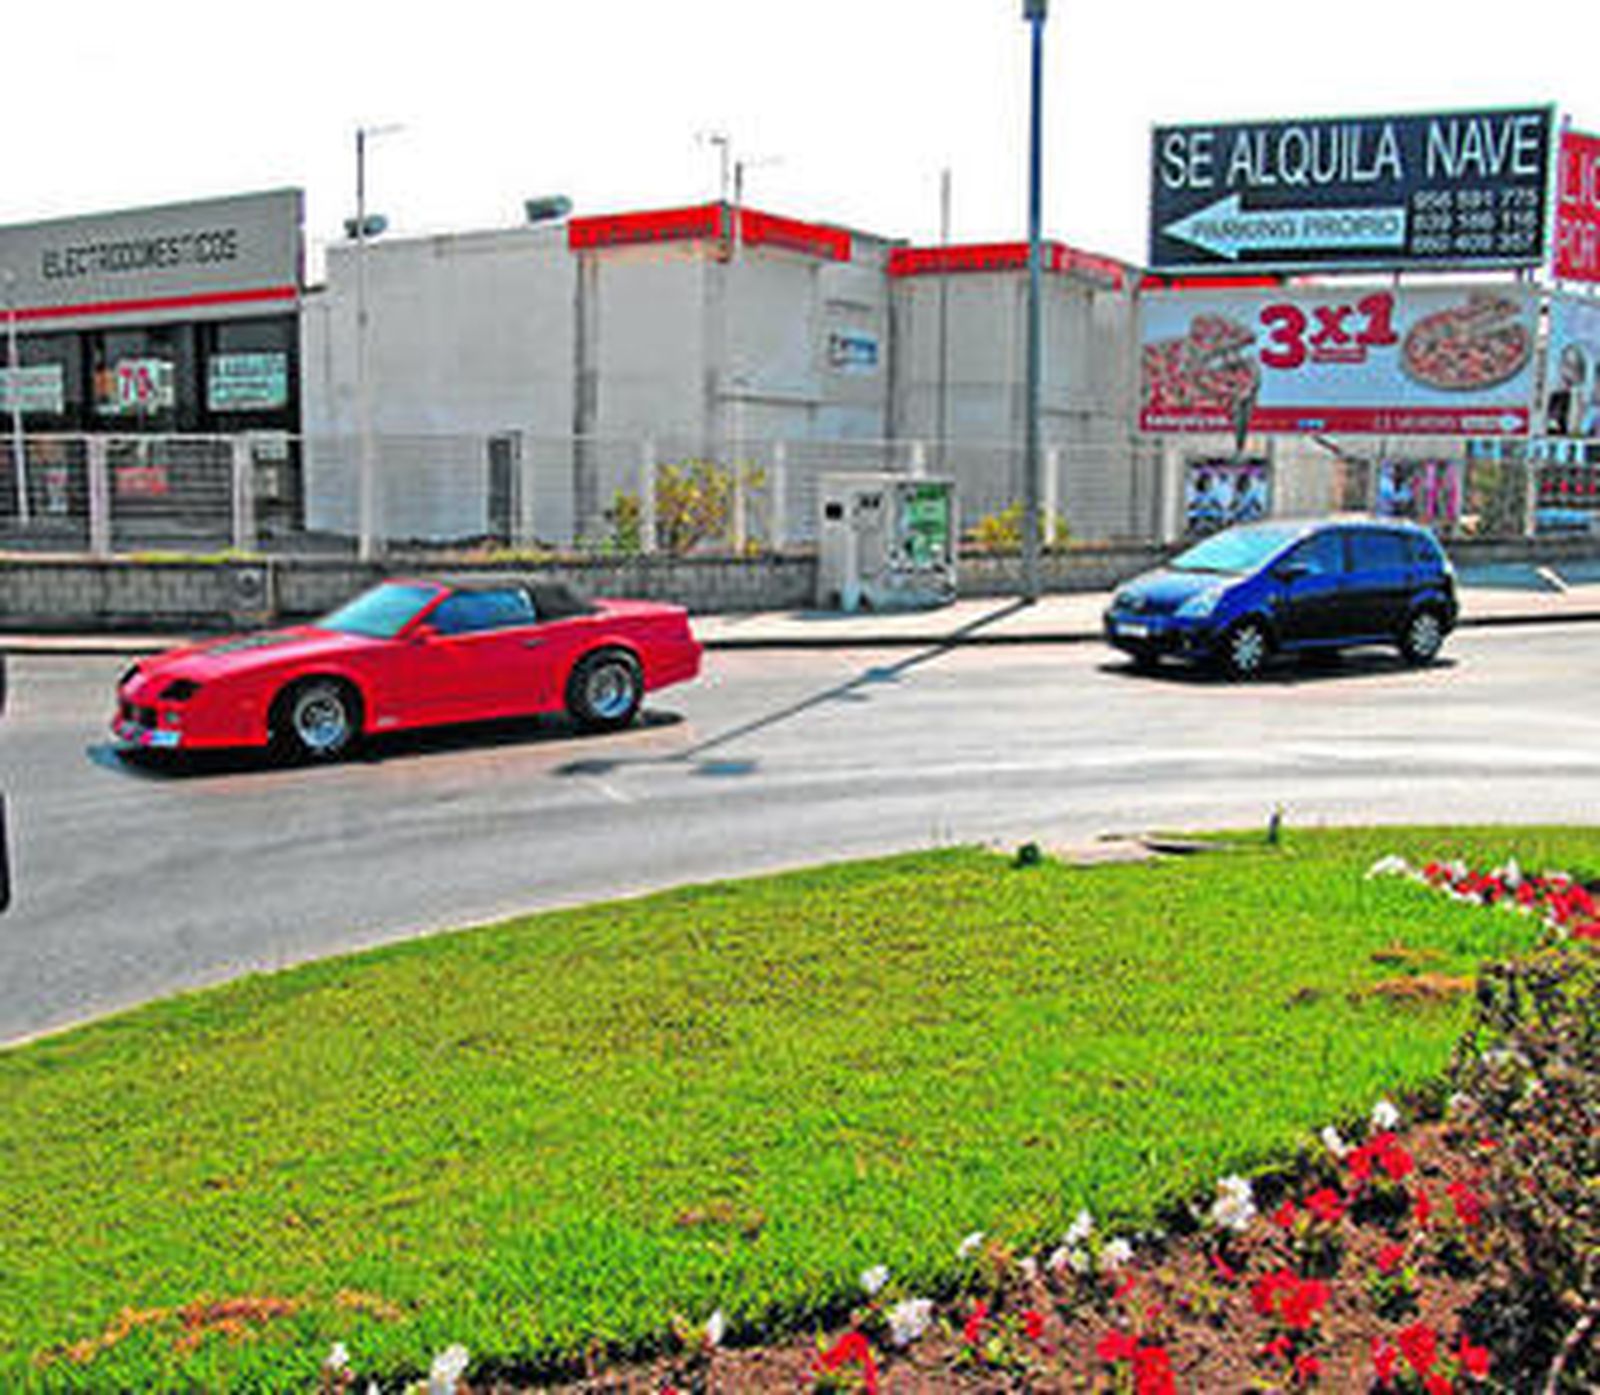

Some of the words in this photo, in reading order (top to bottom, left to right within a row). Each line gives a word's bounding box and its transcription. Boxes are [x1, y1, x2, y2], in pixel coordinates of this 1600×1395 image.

[1161, 132, 1214, 187] SE
[1226, 122, 1402, 185] ALQUILA
[1426, 115, 1541, 178] NAVE
[1191, 216, 1297, 242] PARKING
[1302, 213, 1400, 239] PROPIO
[1258, 290, 1399, 370] 3x1
